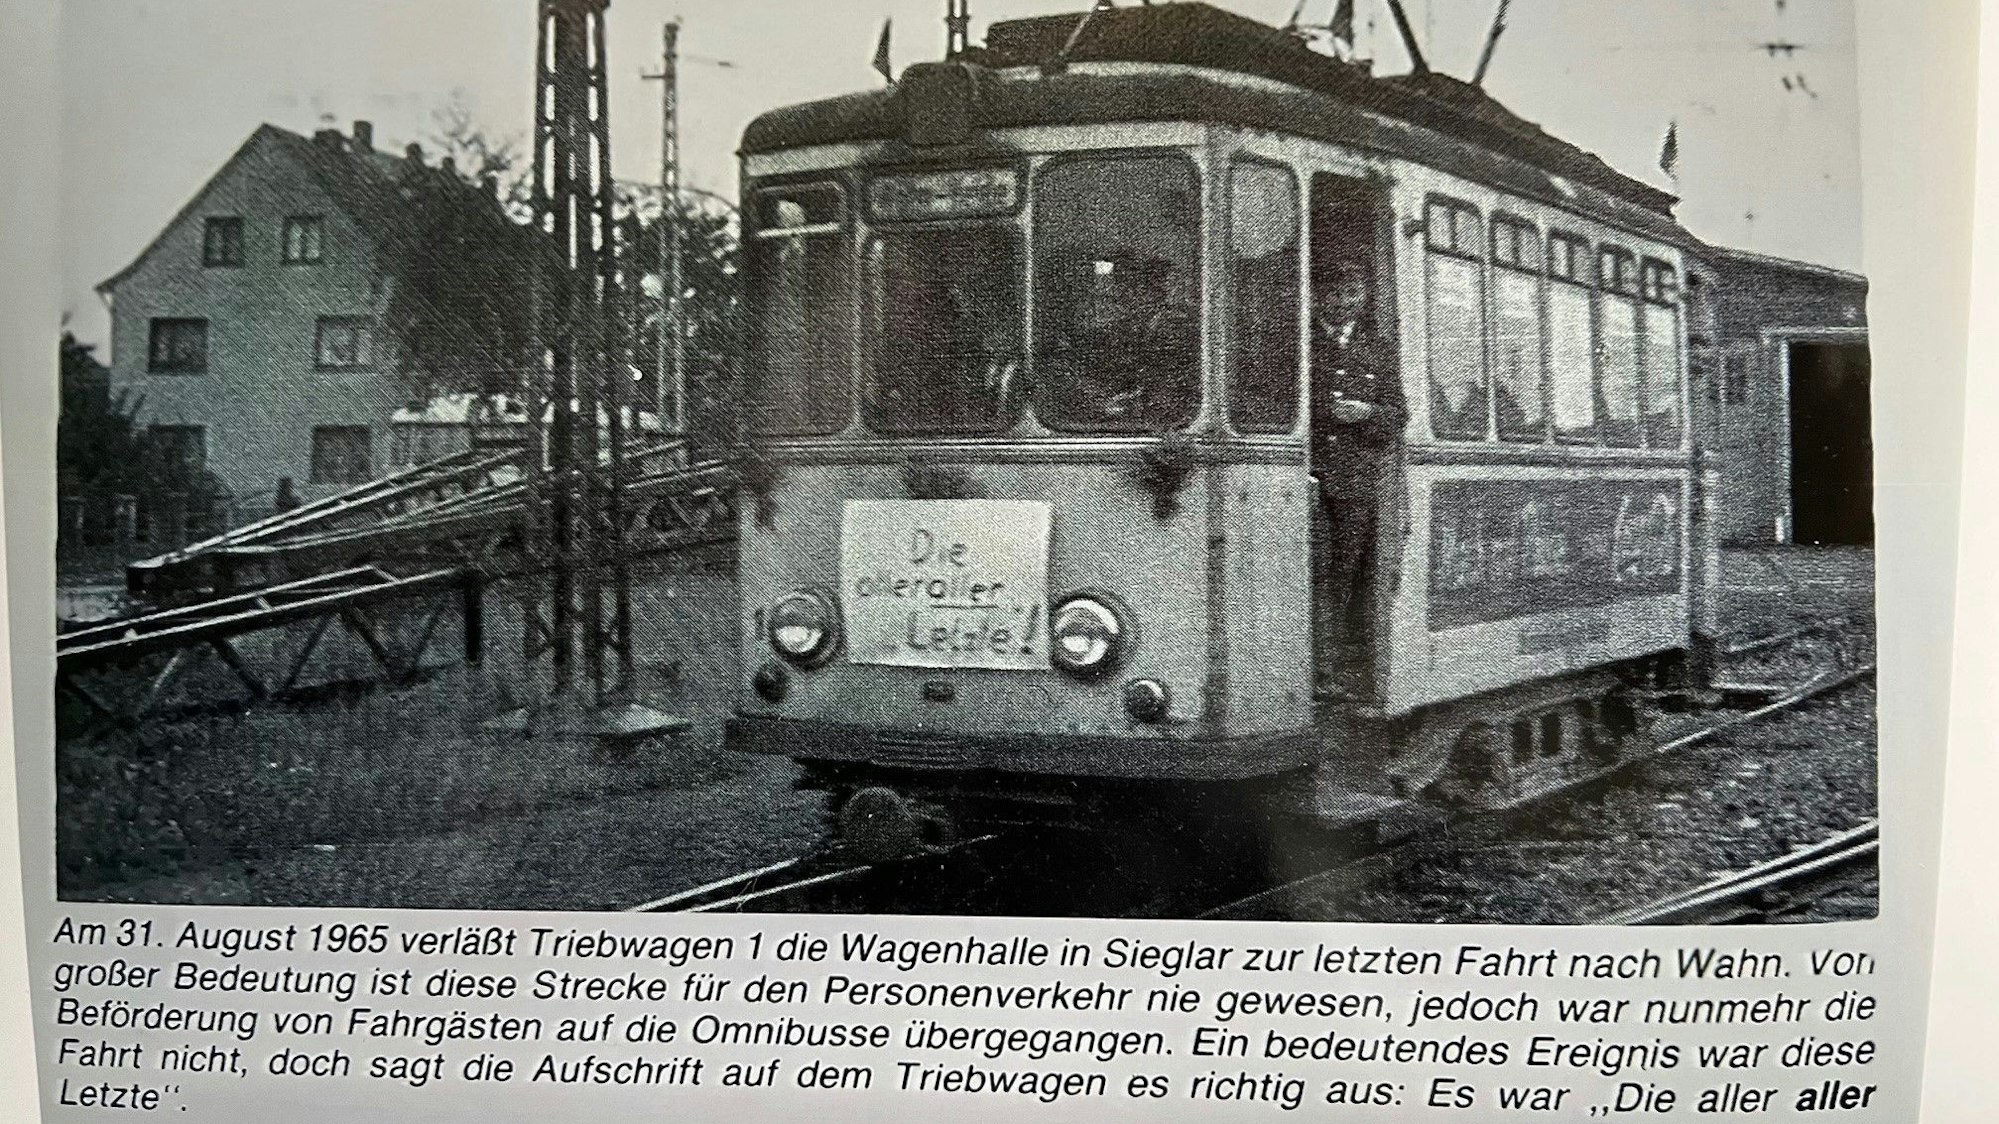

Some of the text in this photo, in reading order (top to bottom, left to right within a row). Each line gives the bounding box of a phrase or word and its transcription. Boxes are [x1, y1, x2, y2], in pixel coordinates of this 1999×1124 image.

[909, 526, 969, 568] Die
[52, 916, 1876, 980] Am 31. August 1965 verläßt Triebwagen 1 die Wagenhalle in Sieglar zur letzten Fahrt nach Wahn. Von
[53, 958, 1877, 1028] großer Bedeutung ist diese Strecke für den Personenverkehr nie gewesen, jedoch war nunmehr die
[57, 997, 1876, 1077] Beförderung von Fahrgästen auf die Omnibusse übergegangen. Ein bedeutendes Ereignis war diese
[58, 1038, 143, 1070] Fahrt
[161, 1043, 247, 1079] nicht,
[268, 1047, 351, 1077] doch
[369, 1053, 446, 1088] sagt
[463, 1053, 514, 1082] die
[531, 1054, 704, 1086] Aufschrift
[721, 1058, 781, 1088] auf
[796, 1059, 872, 1089] dem
[896, 1061, 1107, 1104] Triebwagen
[1127, 1074, 1170, 1099] es
[1190, 1070, 1306, 1111] richtig
[1325, 1080, 1405, 1106] aus:
[1427, 1077, 1475, 1109] Es
[1499, 1087, 1571, 1111] war
[1697, 1082, 1779, 1114] aller
[1795, 1079, 1878, 1112] aller
